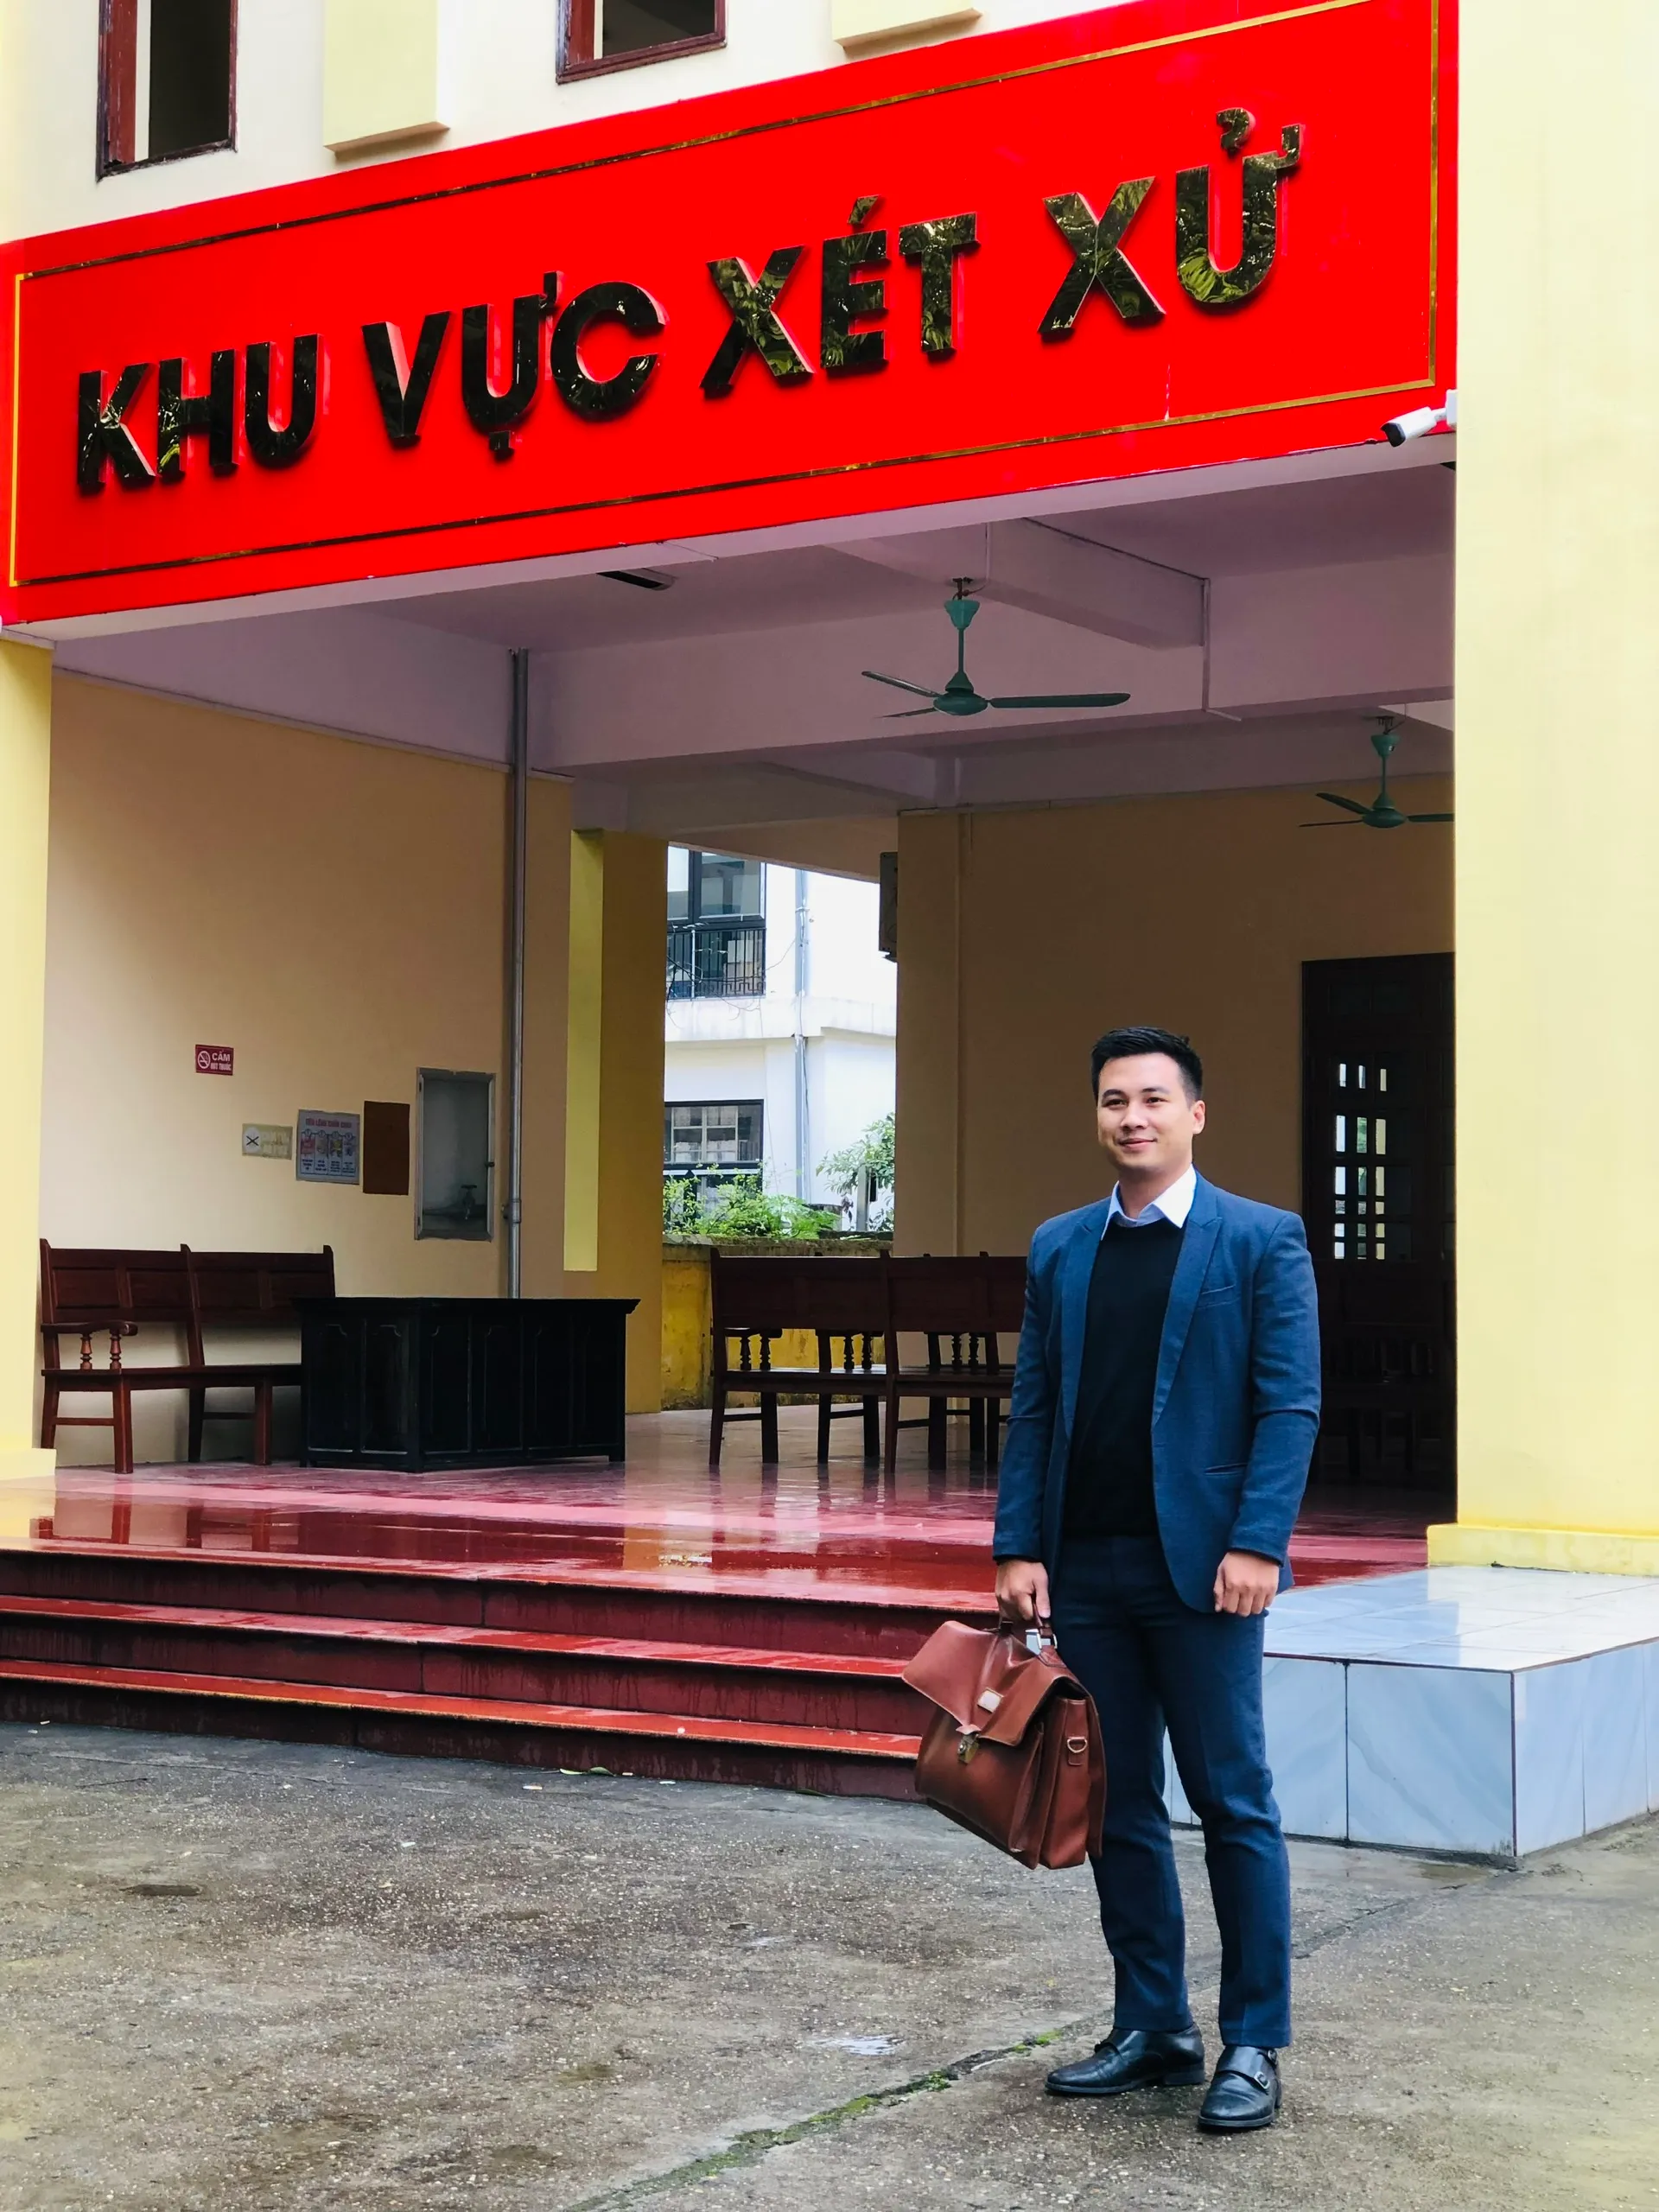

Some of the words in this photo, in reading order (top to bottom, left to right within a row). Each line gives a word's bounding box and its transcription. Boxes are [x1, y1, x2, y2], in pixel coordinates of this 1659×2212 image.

[76, 334, 321, 494] KHU
[362, 271, 665, 463] VỰC
[700, 195, 982, 397] XÉT
[1038, 107, 1303, 344] XỬ
